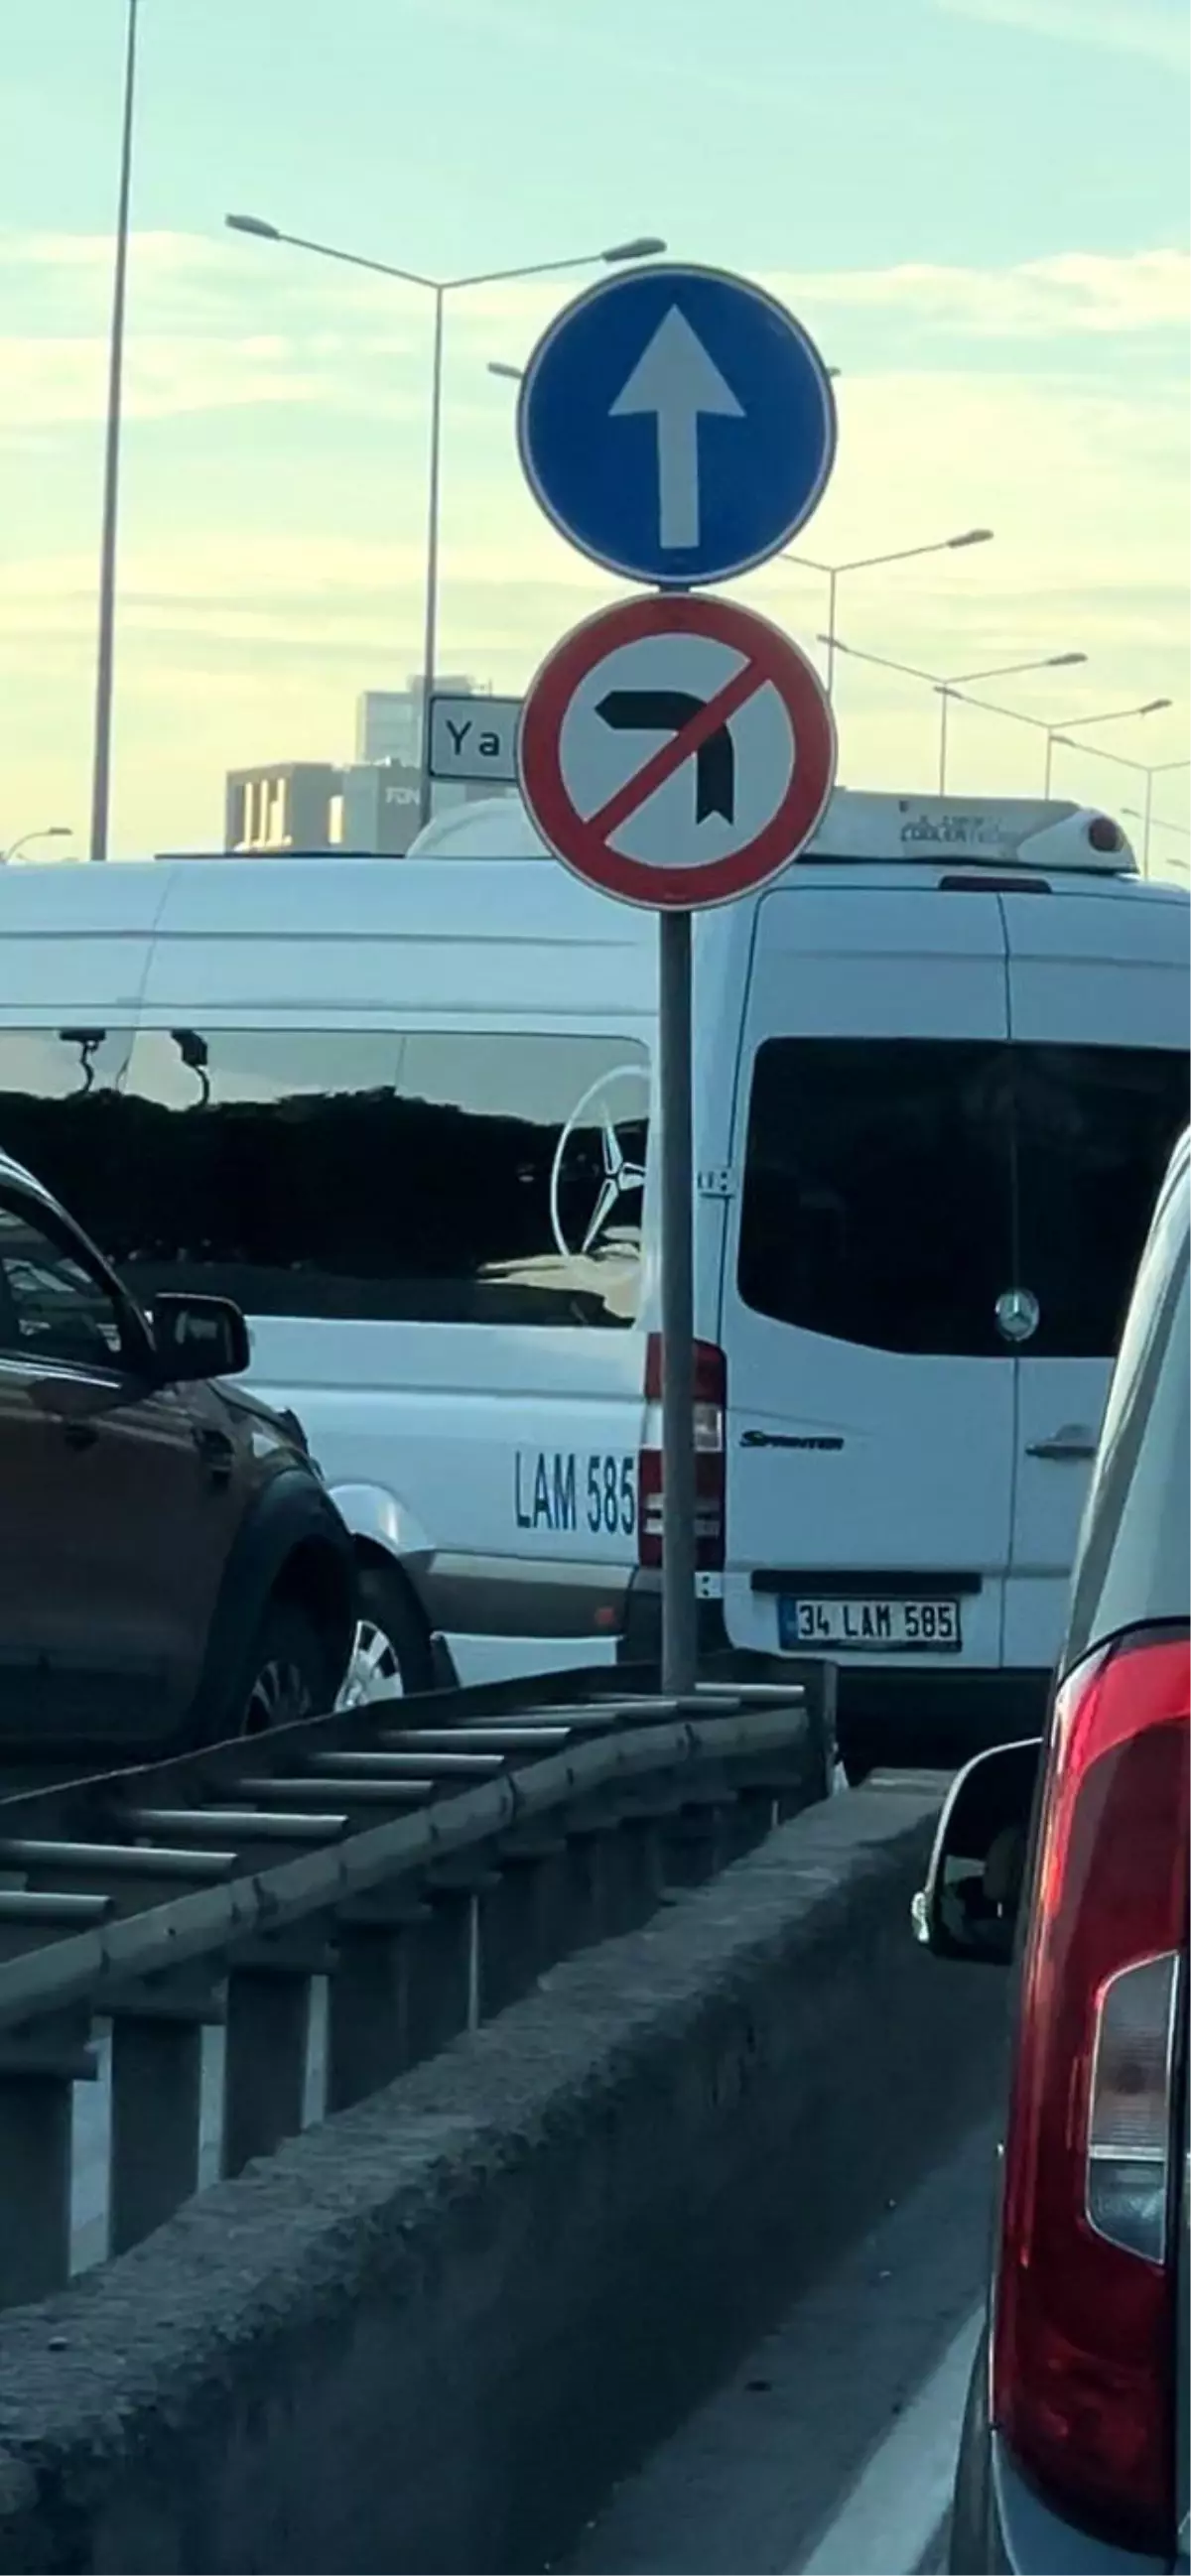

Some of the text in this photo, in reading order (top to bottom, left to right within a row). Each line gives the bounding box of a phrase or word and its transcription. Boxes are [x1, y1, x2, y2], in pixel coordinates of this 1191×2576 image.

[514, 1450, 635, 1535] LAM 585
[799, 1604, 953, 1638] 34 LAM 585
